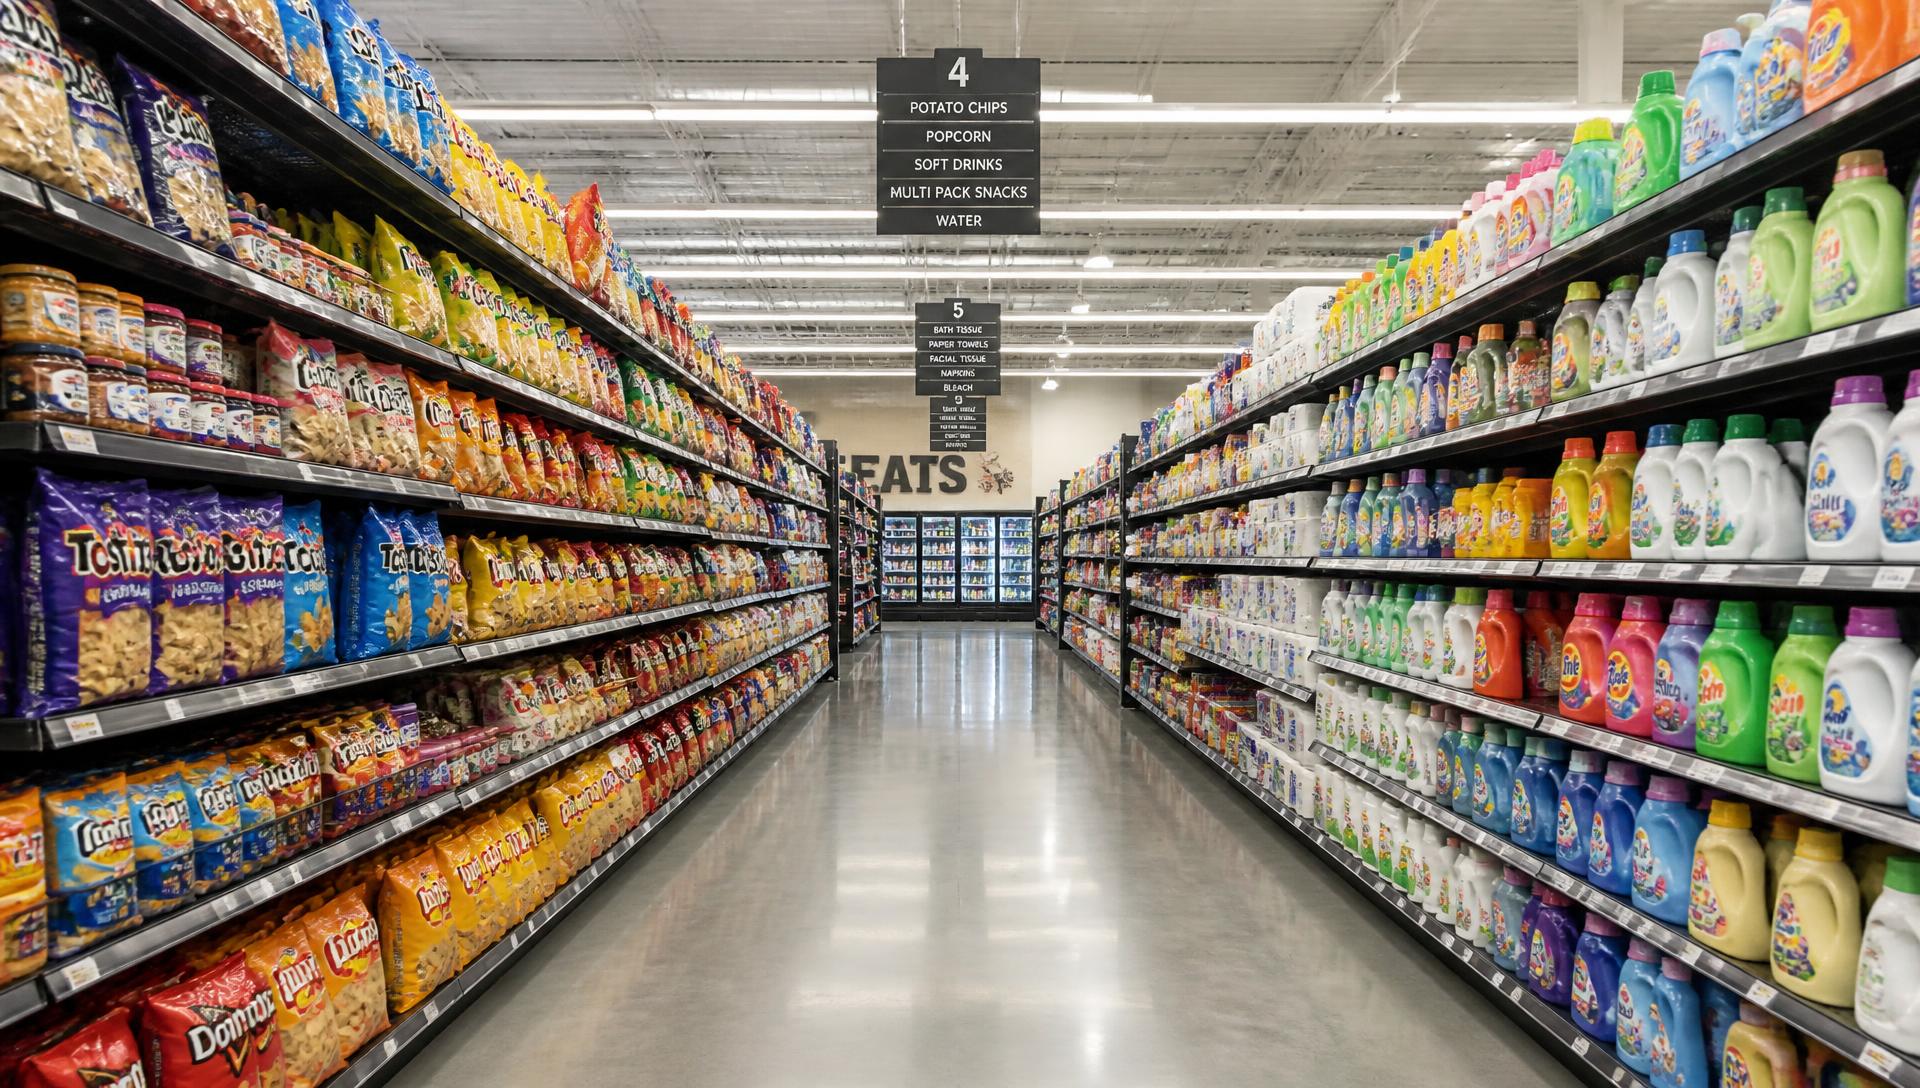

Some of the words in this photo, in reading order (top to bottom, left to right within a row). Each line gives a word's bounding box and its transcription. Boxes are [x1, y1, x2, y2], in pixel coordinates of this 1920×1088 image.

[948, 56, 969, 87] 4
[910, 102, 964, 114] POTATO
[968, 102, 1008, 114] CHIPS
[926, 130, 991, 142] POPCORN
[914, 158, 949, 171] SOFT
[953, 158, 1003, 171] DRINKS
[890, 186, 931, 199] MULTI
[935, 186, 971, 199] PACK
[975, 186, 1028, 199] SNACKS
[936, 214, 982, 227] WATER
[953, 302, 964, 318] 5
[933, 326, 954, 334] BATH
[956, 326, 983, 334] TISSUE
[928, 340, 955, 348] PAPER
[957, 340, 989, 348] TOWELS
[929, 355, 957, 363] FACIAL
[960, 355, 987, 363] TISSUE
[940, 369, 976, 377] NAPKINS
[943, 383, 973, 392] BLEACH
[839, 454, 967, 494] EATS
